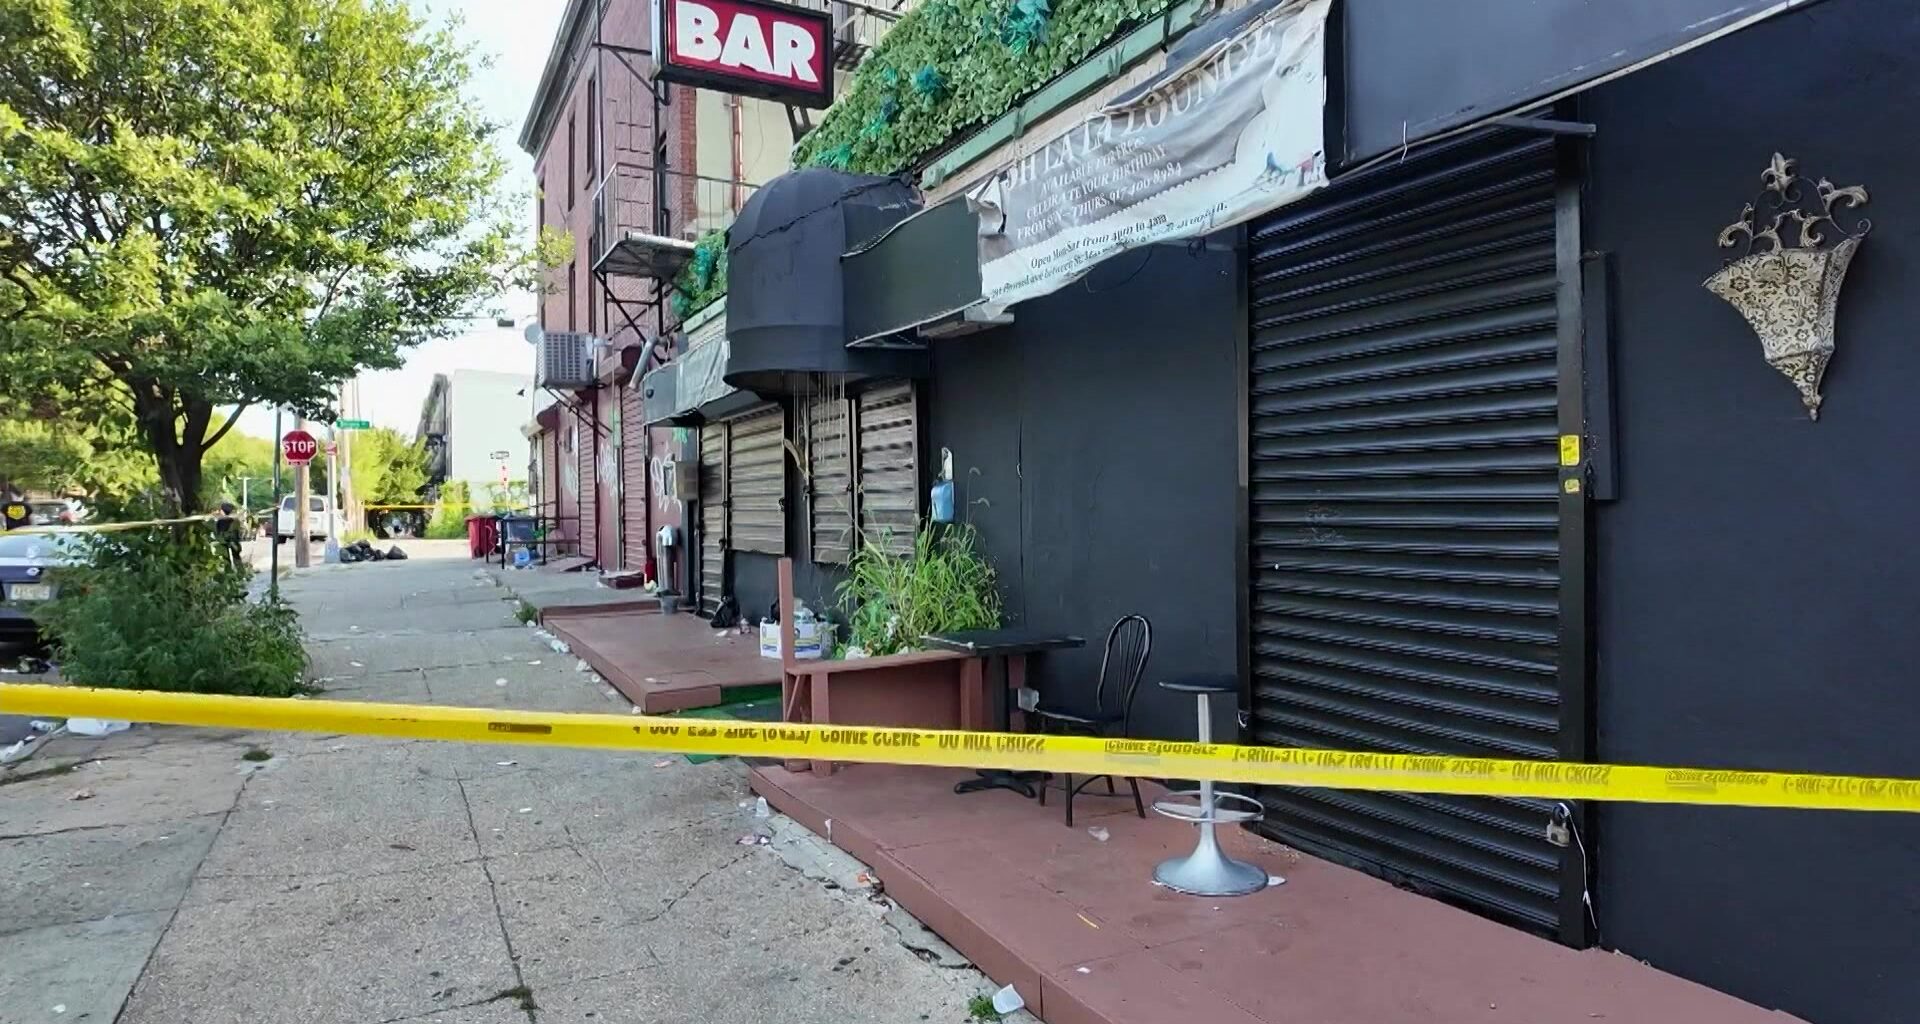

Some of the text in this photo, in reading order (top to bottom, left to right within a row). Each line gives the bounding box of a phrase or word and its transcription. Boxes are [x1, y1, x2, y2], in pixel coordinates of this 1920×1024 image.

[676, 1, 818, 82] BAR
[1043, 133, 1076, 174] LA
[1082, 173, 1109, 196] YOUR
[1112, 143, 1168, 184] BIRTHDAY
[1031, 254, 1051, 269] Open
[283, 440, 315, 454] STOP
